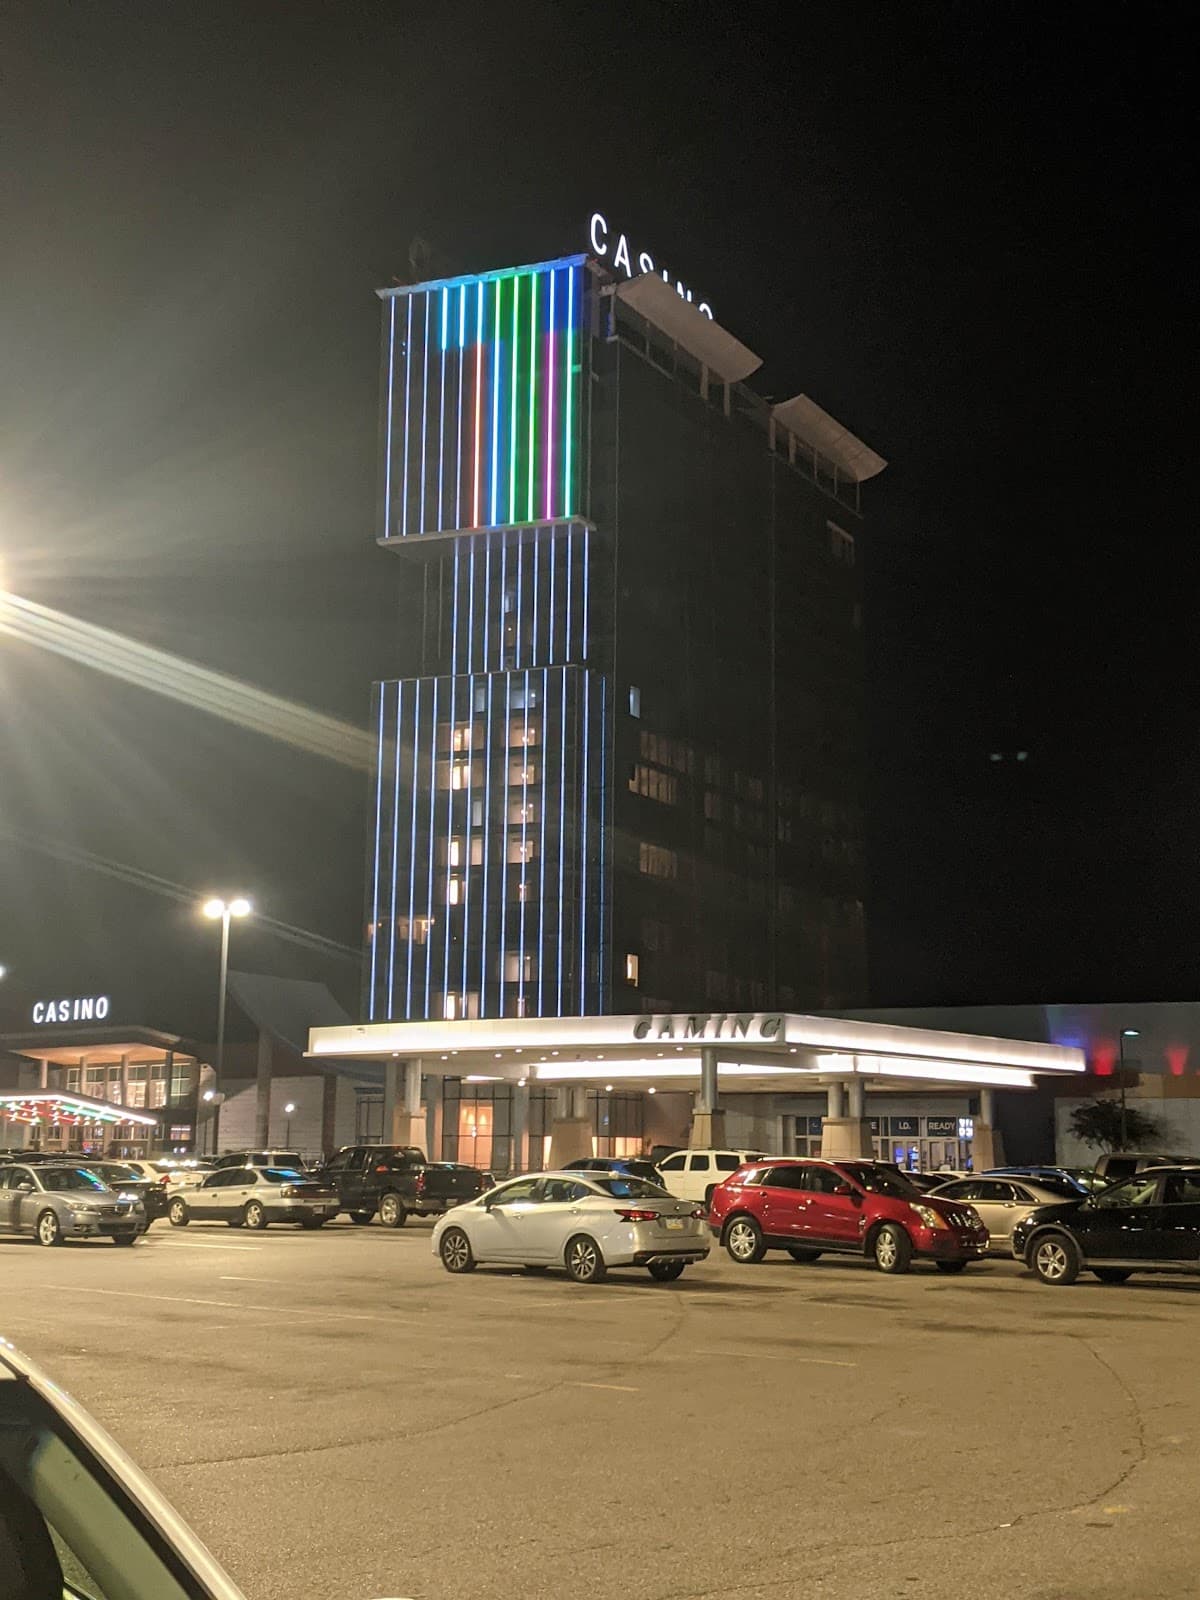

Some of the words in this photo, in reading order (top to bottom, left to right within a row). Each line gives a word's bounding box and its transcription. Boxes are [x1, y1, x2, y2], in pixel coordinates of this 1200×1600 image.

[33, 996, 109, 1023] CASINO
[633, 1016, 781, 1040] GAMING
[928, 1121, 955, 1130] READY
